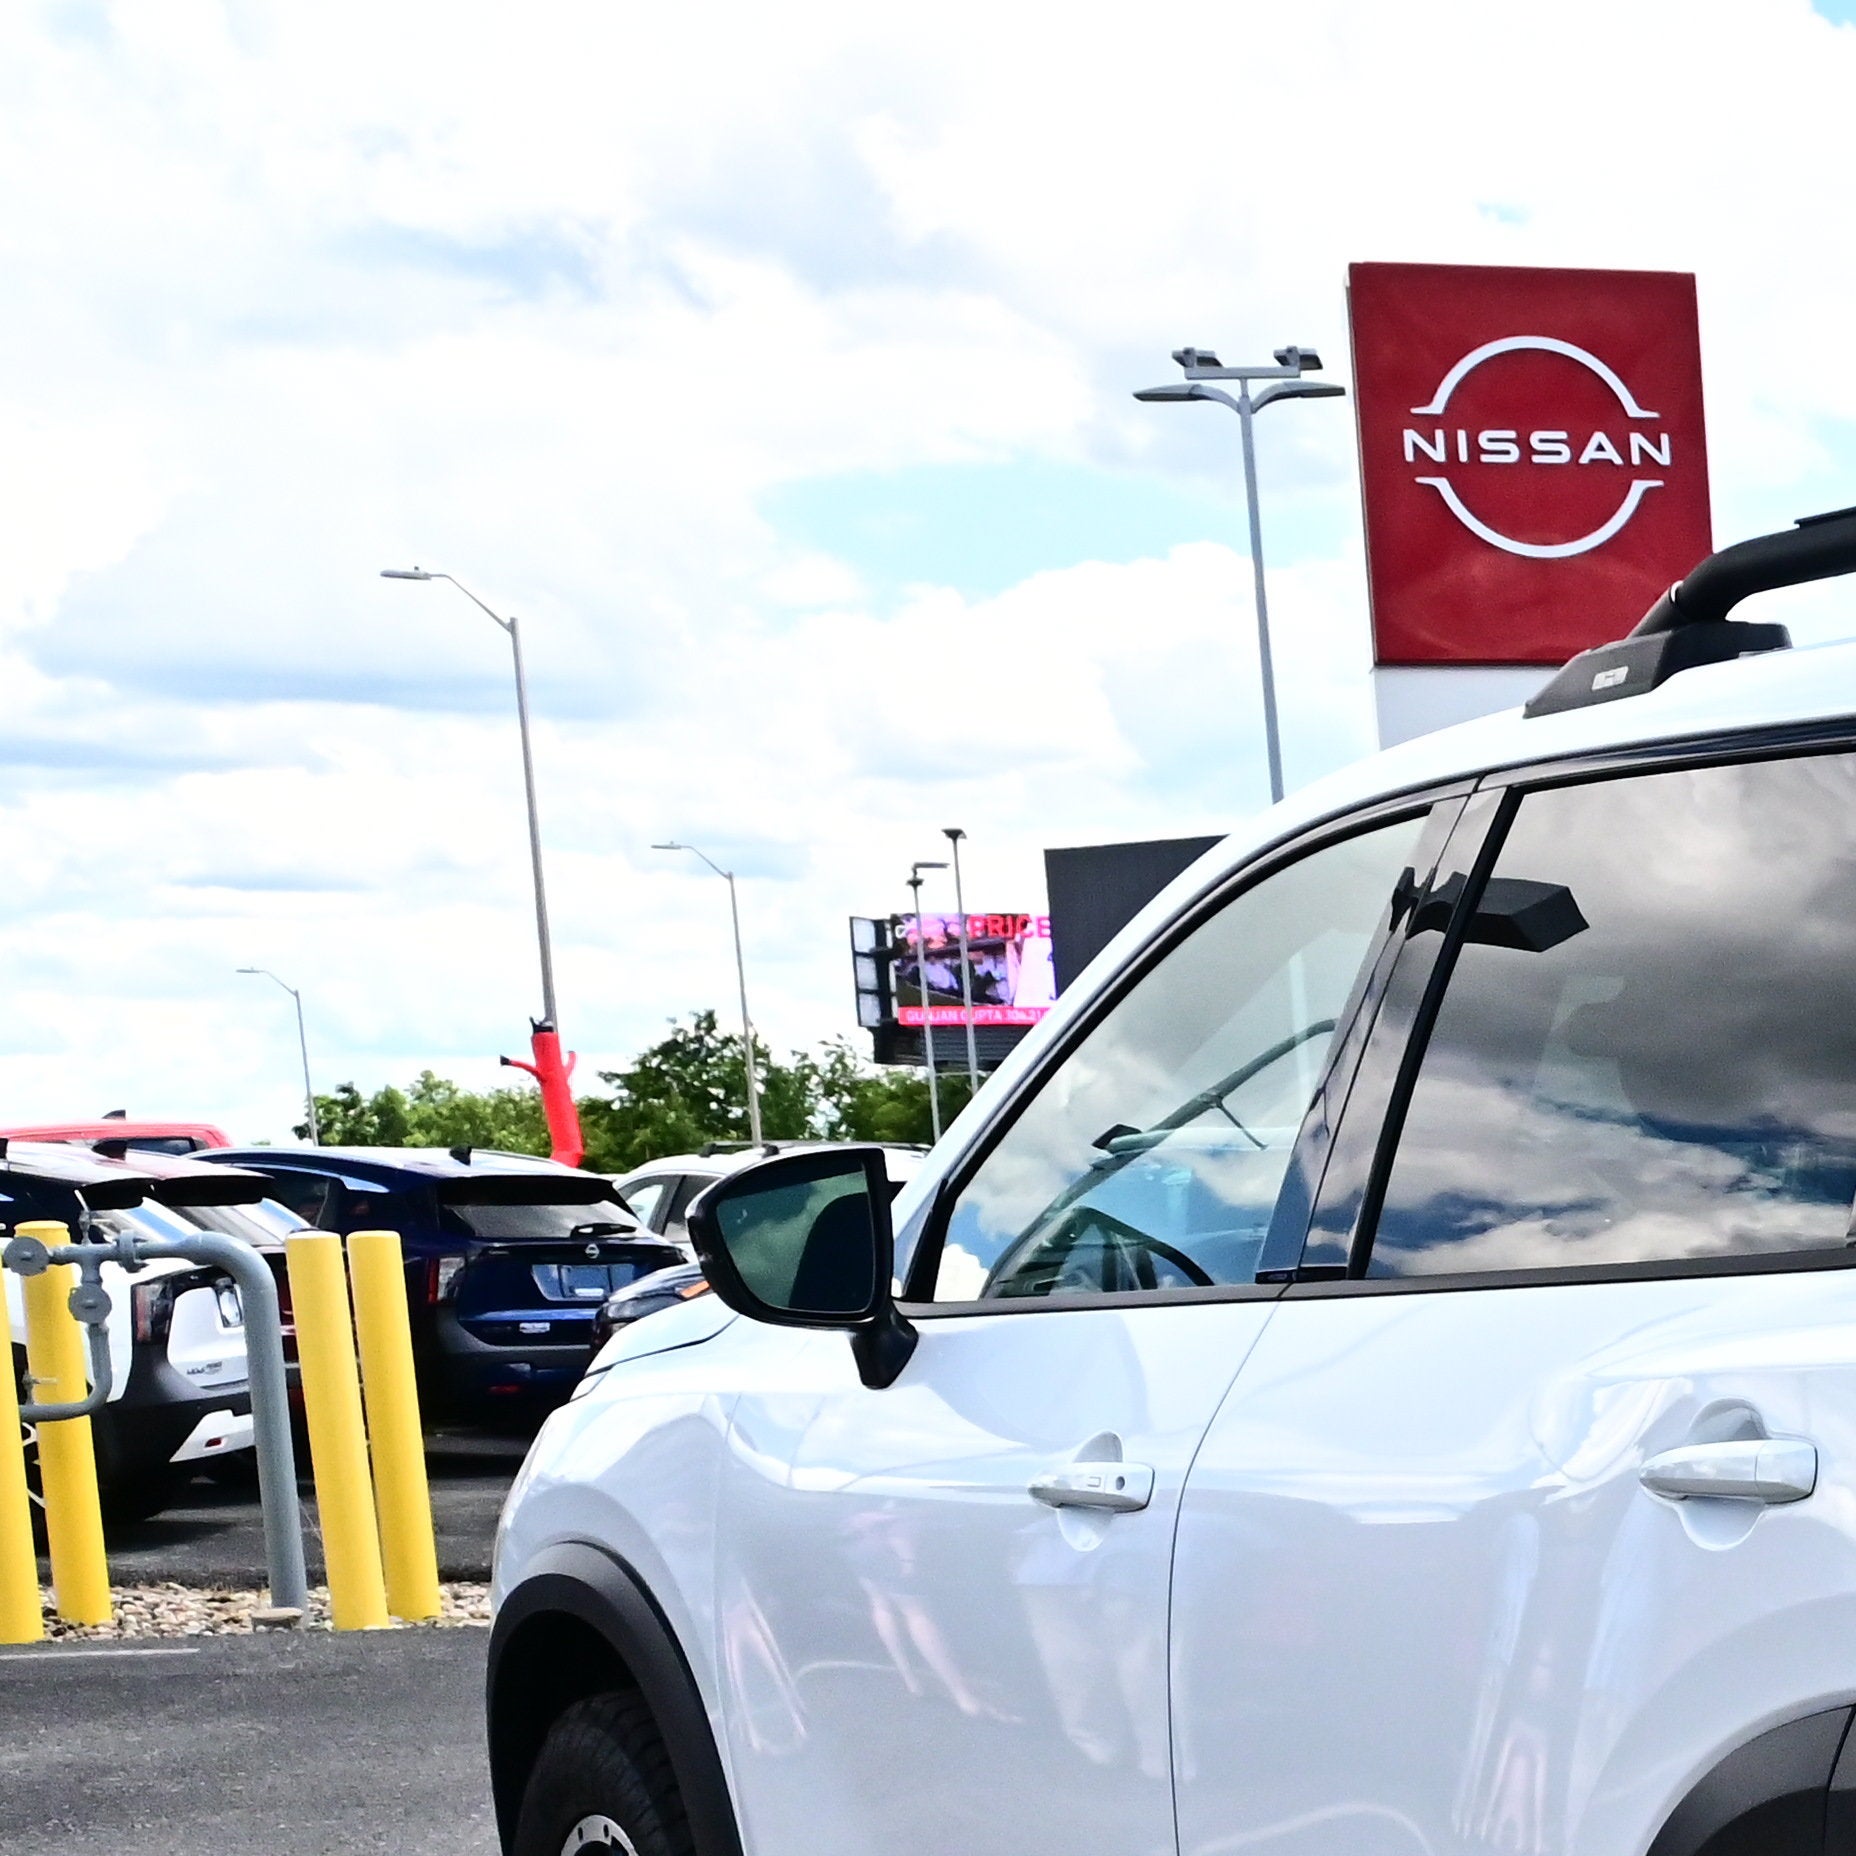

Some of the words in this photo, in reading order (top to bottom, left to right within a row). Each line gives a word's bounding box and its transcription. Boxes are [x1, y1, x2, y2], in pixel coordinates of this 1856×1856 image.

[1403, 429, 1671, 466] NISSAN
[968, 914, 1050, 938] PRICE
[960, 1009, 1003, 1022] GPTA
